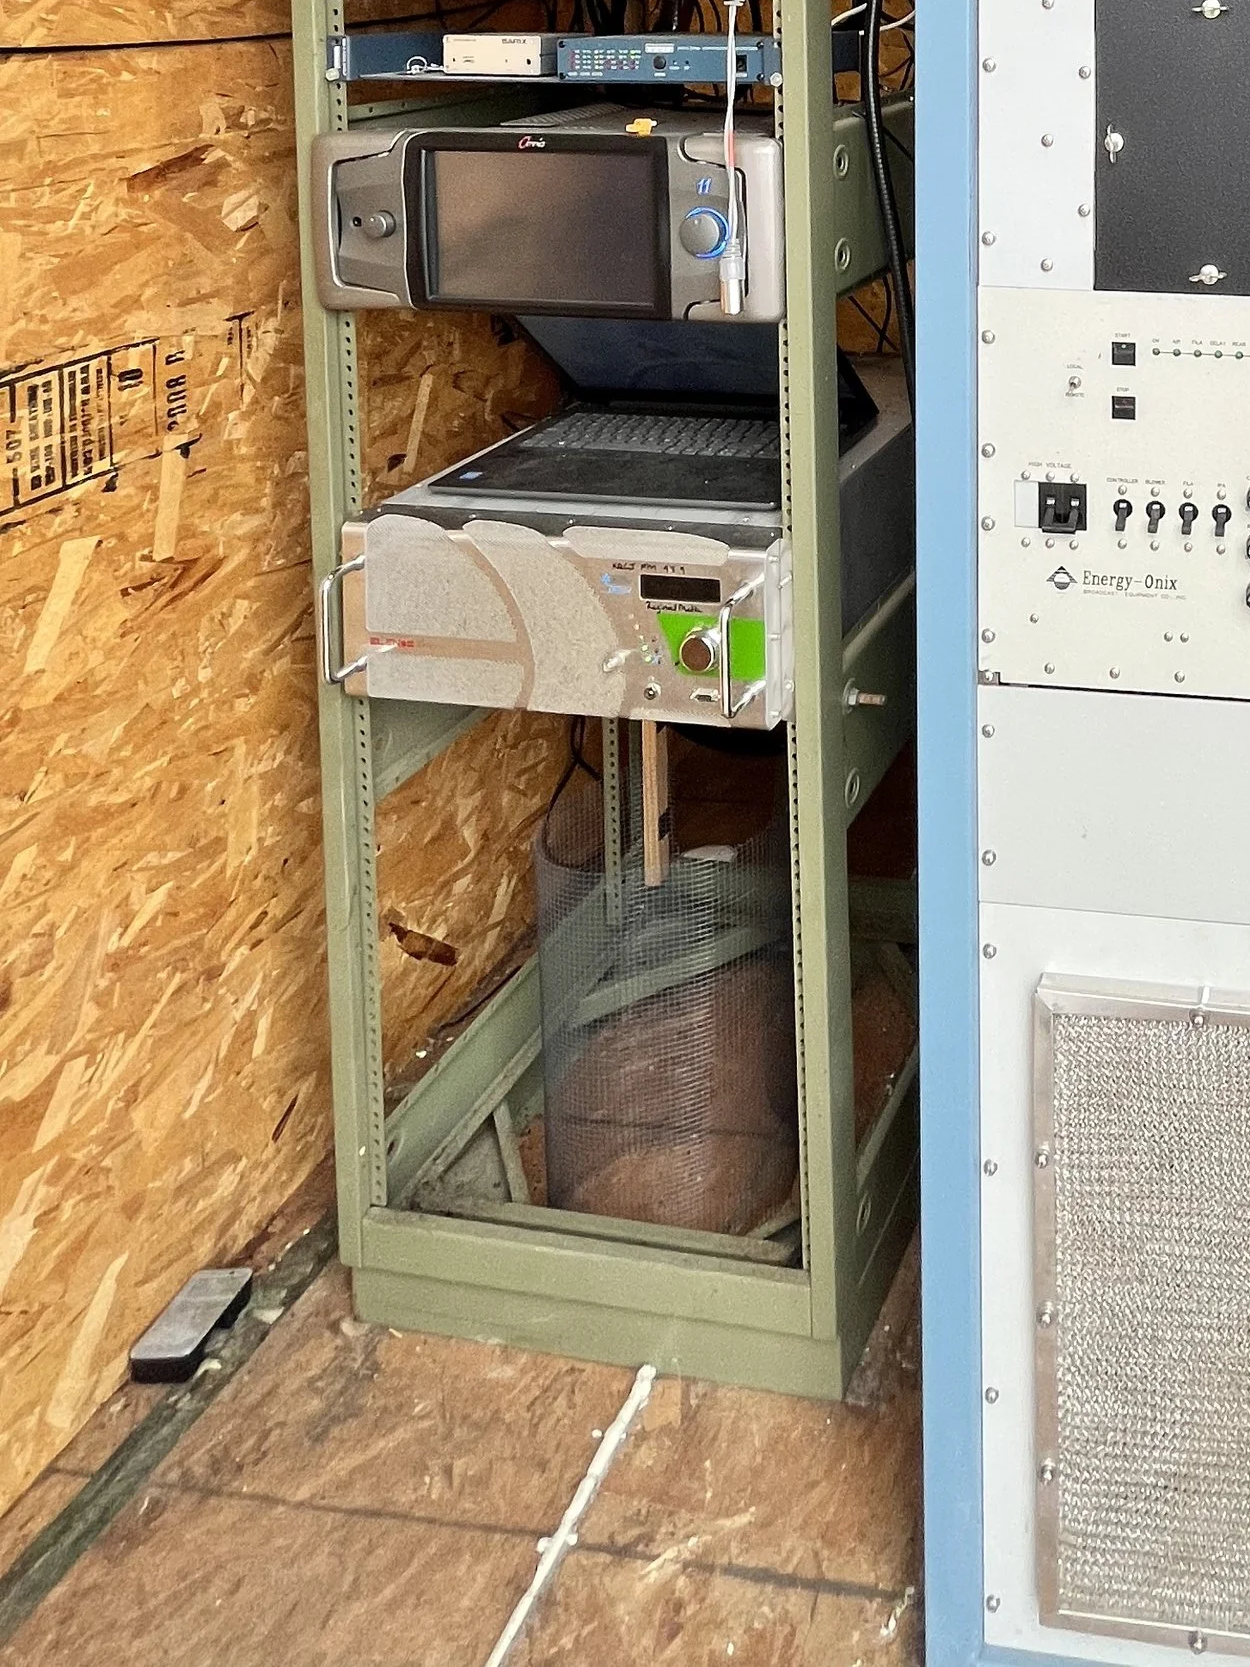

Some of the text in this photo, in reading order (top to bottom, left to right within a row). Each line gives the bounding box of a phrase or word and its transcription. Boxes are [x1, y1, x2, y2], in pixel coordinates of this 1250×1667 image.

[697, 177, 712, 195] 11
[4, 428, 24, 465] 507
[1082, 570, 1178, 592] Energy-Onix
[1124, 591, 1159, 599] EQUIPMENT
